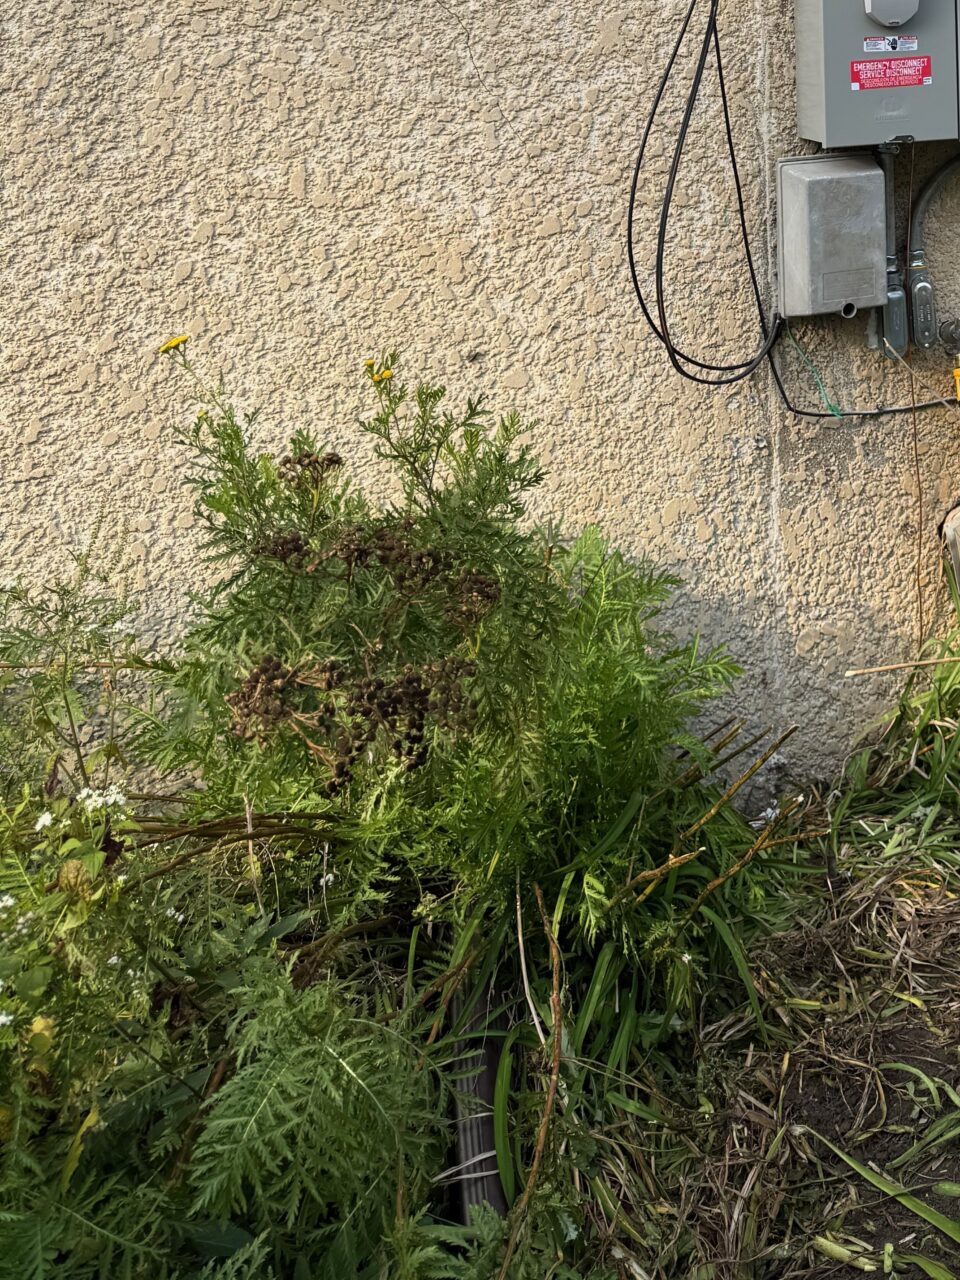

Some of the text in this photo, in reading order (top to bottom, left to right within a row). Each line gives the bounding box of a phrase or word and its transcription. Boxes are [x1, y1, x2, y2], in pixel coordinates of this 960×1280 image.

[853, 58, 928, 71] EMERGENCY DISCONNECT
[859, 67, 922, 79] SERVICE DISCONNECT
